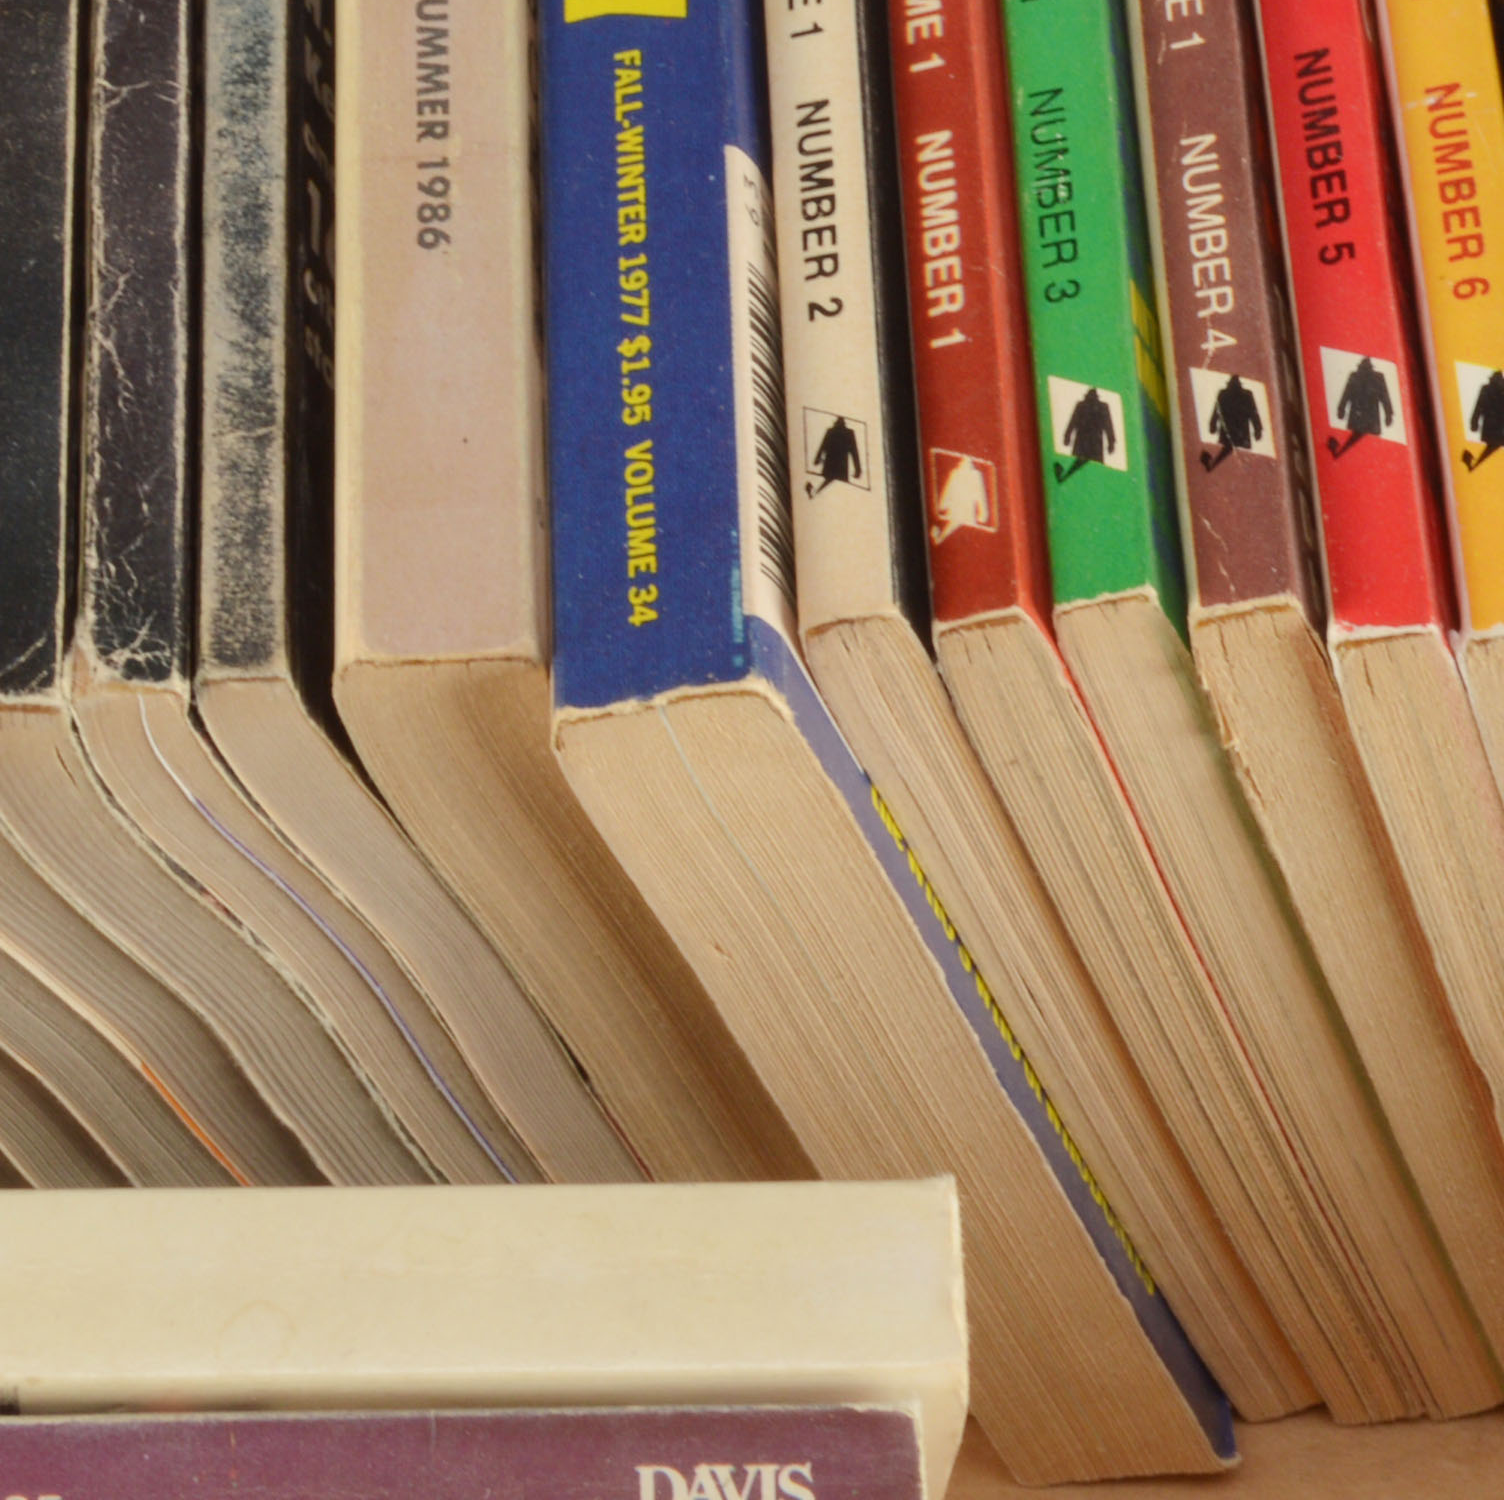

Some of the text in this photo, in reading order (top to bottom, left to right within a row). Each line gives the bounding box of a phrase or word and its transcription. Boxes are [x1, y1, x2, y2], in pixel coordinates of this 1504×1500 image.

[416, 157, 451, 249] 1986
[796, 99, 843, 321] NUMBER 2
[917, 130, 966, 347] NUMBER 1
[1028, 87, 1080, 303] NUMBER 3
[1181, 134, 1237, 356] NUMBER 4
[1295, 48, 1355, 265] NUMBER 5
[1425, 83, 1490, 300] NUMBER 6
[614, 49, 658, 625] FALL-WINTER 1977 $1.95 VOLUME 34
